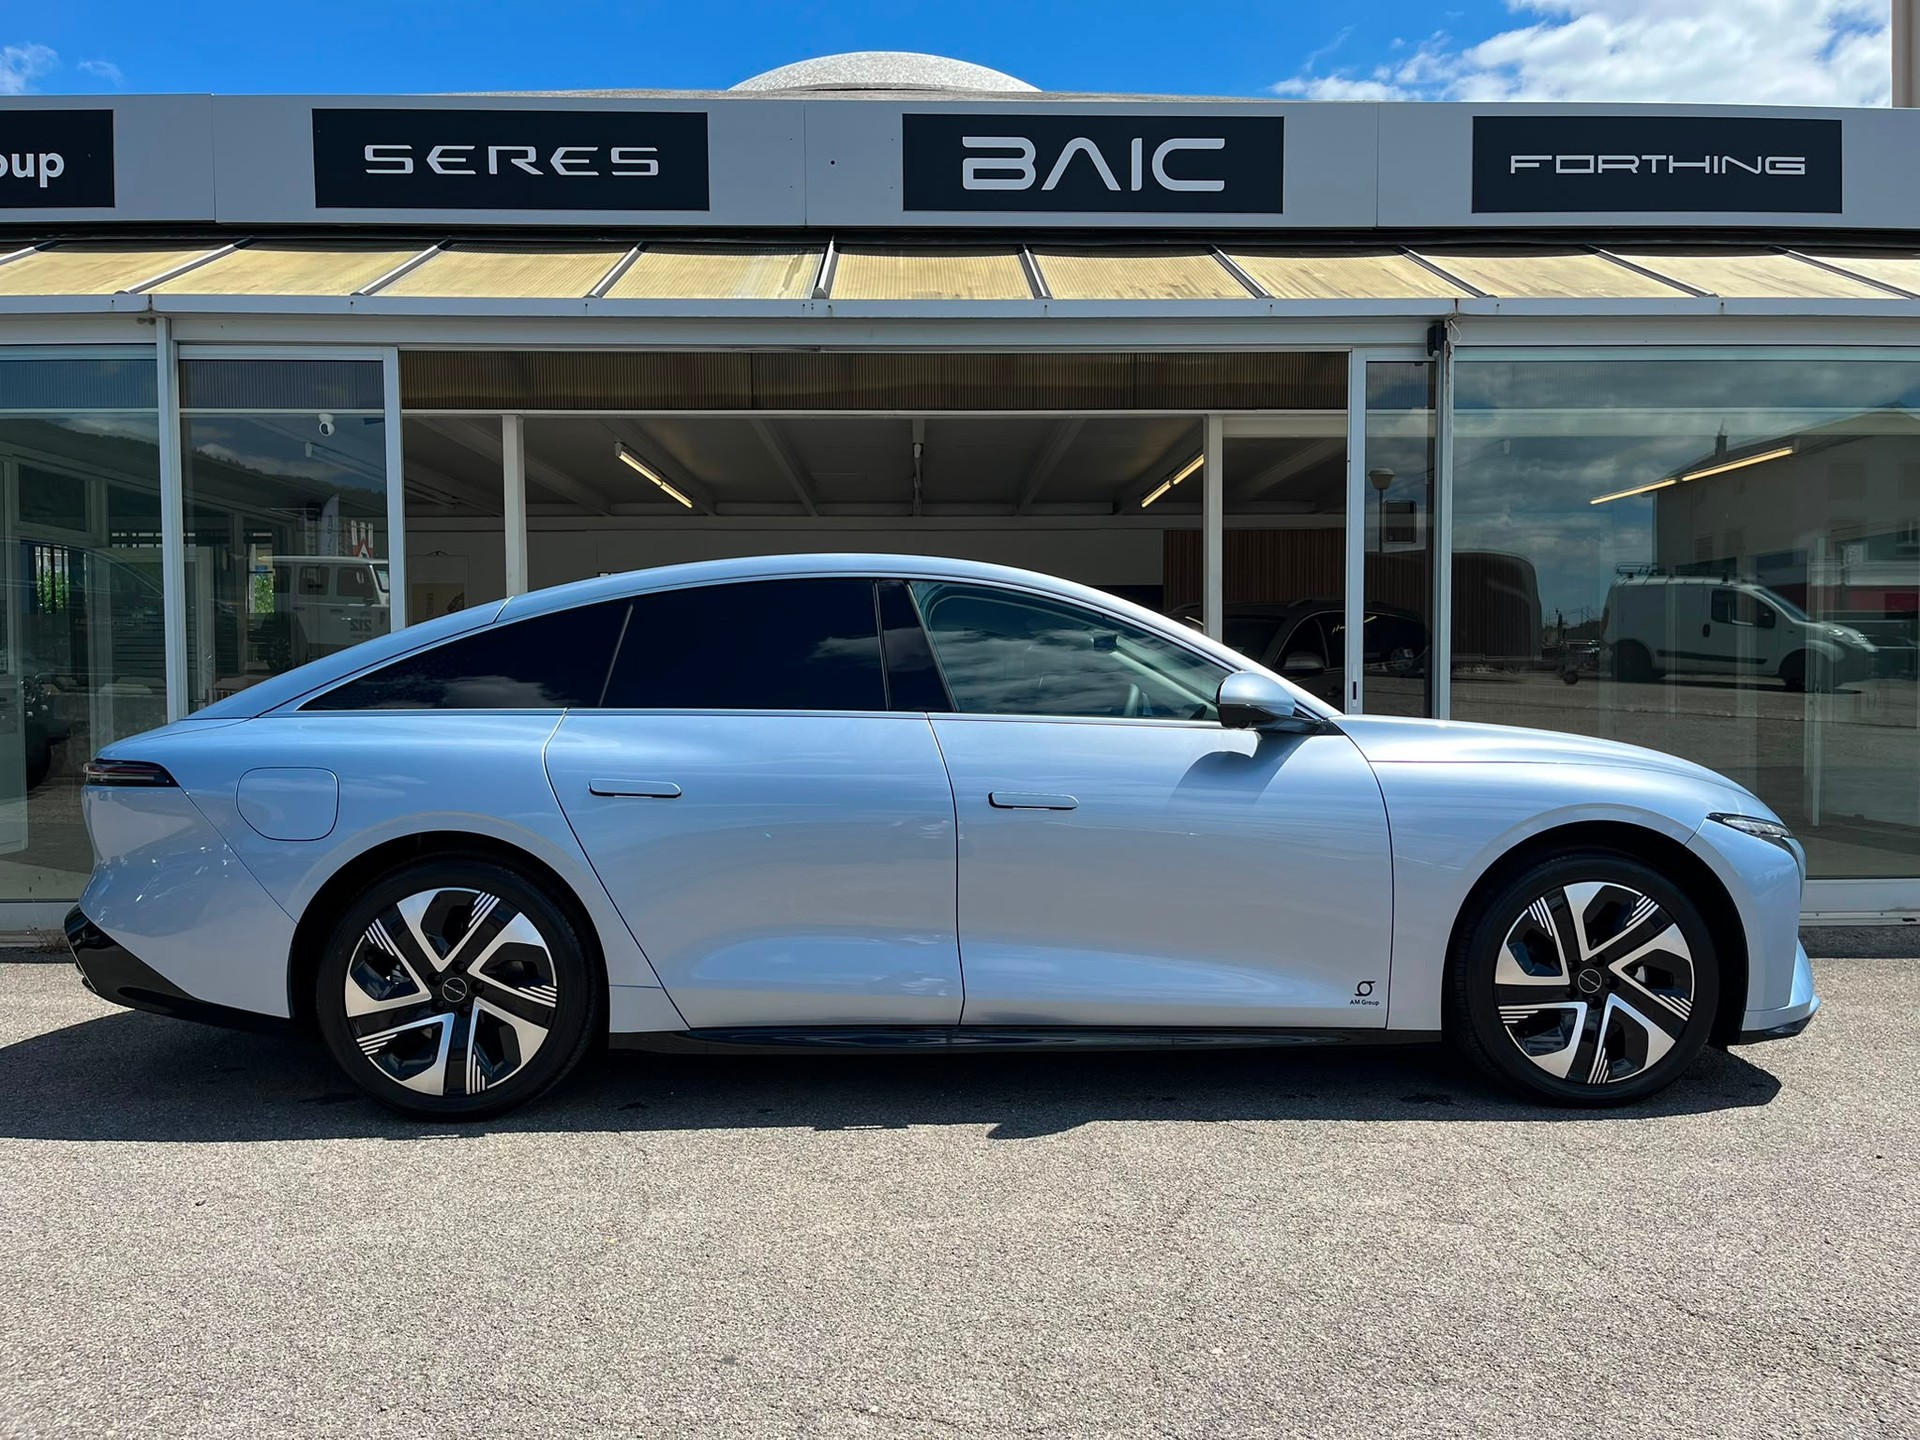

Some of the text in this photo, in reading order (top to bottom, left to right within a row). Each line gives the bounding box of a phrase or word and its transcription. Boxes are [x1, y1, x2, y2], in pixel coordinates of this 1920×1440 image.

[365, 145, 658, 175] SERES
[963, 137, 1225, 191] BAIC
[1511, 155, 1805, 174] FORTHING
